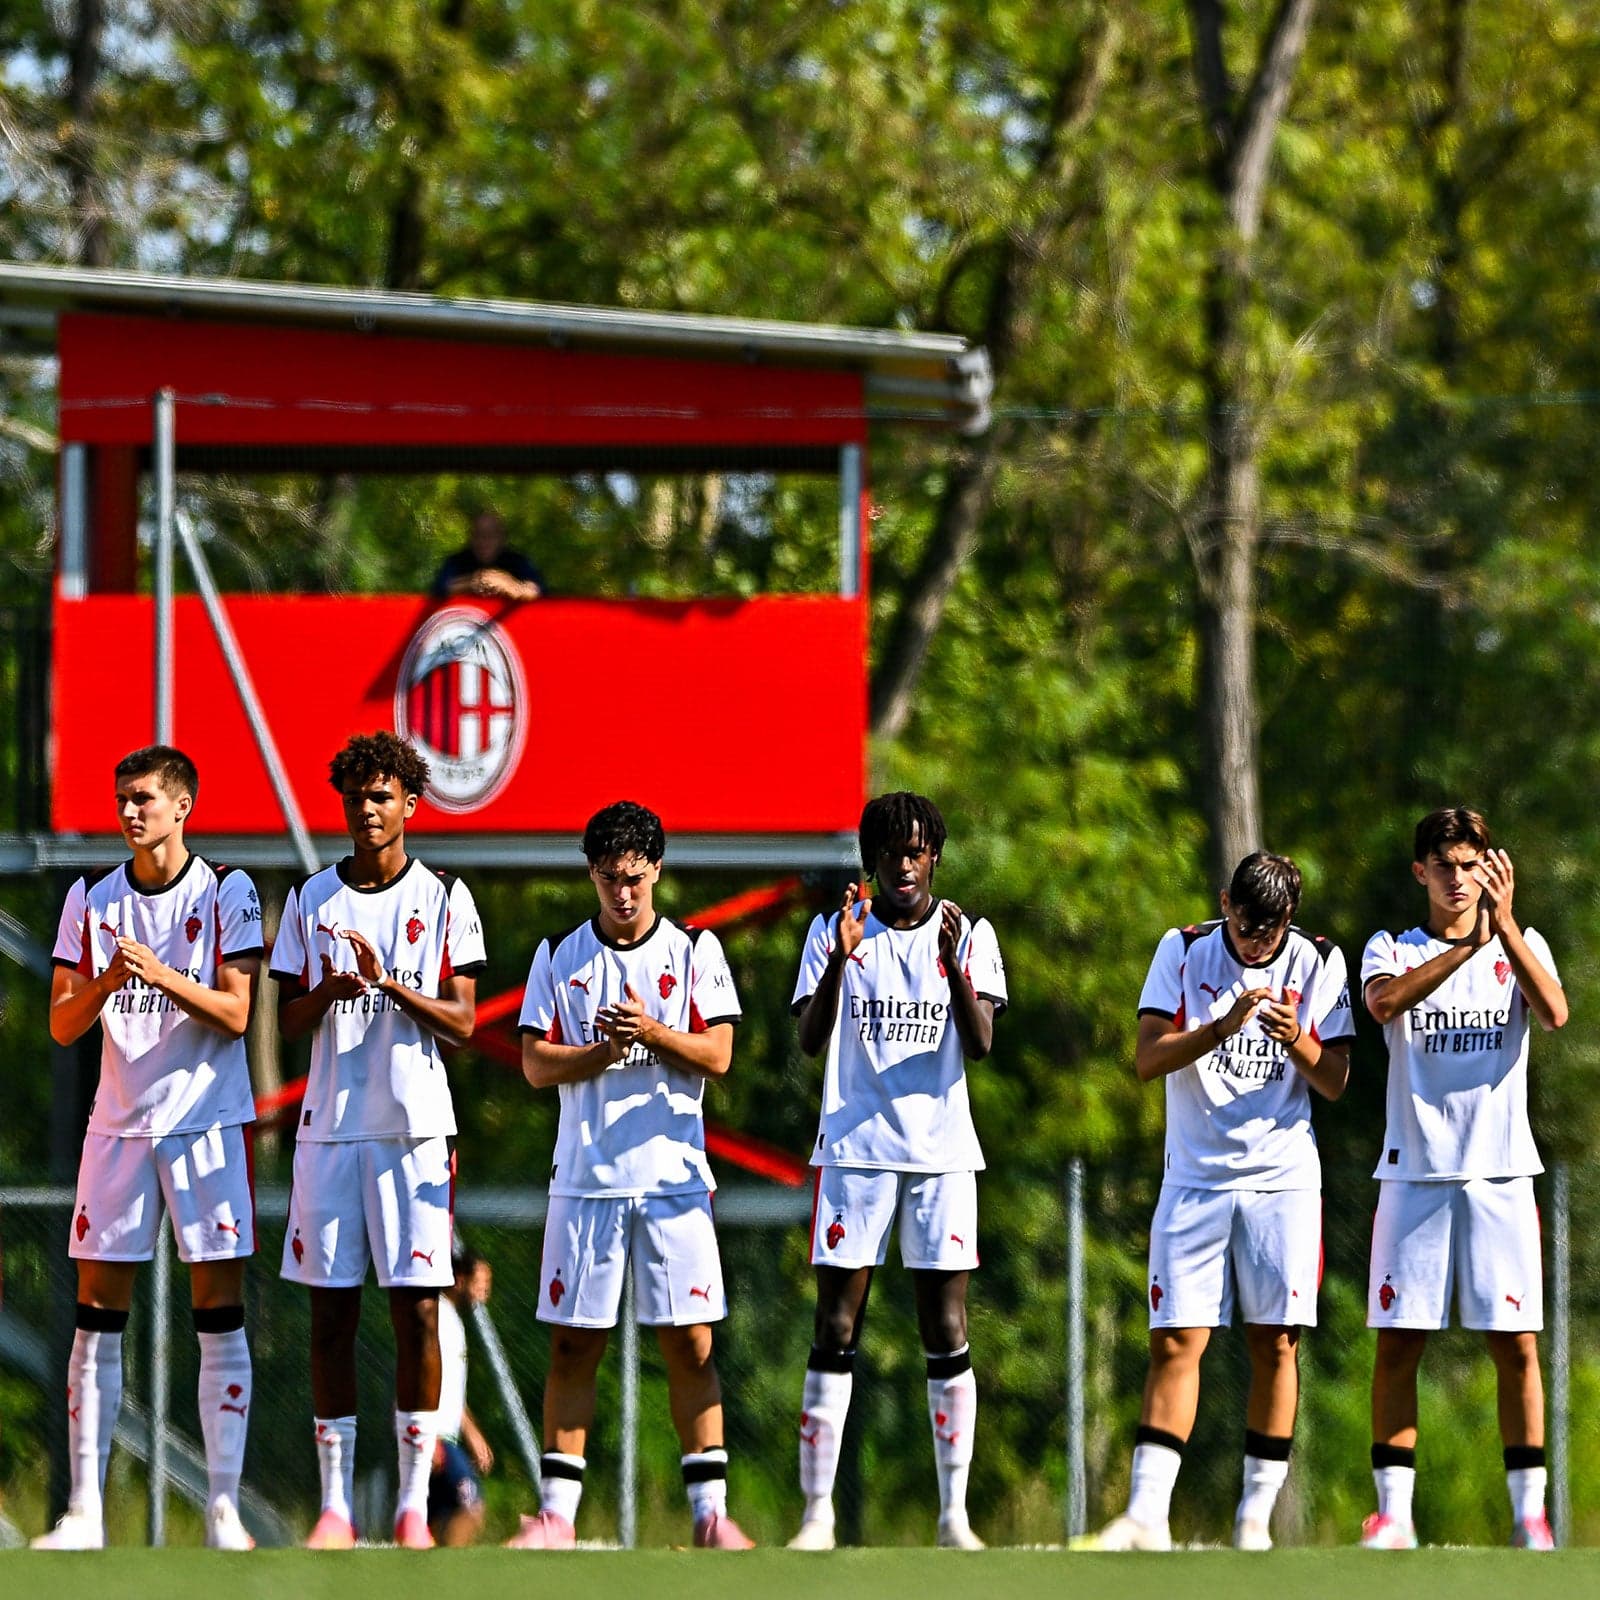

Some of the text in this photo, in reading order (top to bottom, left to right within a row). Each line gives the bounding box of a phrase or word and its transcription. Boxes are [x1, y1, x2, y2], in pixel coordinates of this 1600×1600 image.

[112, 994, 135, 1014] FLY
[333, 997, 357, 1015] FLY
[859, 1022, 938, 1044] FLY BETTER
[1425, 1031, 1503, 1054] FLY BETTER
[1207, 1054, 1286, 1081] FLY BETTER
